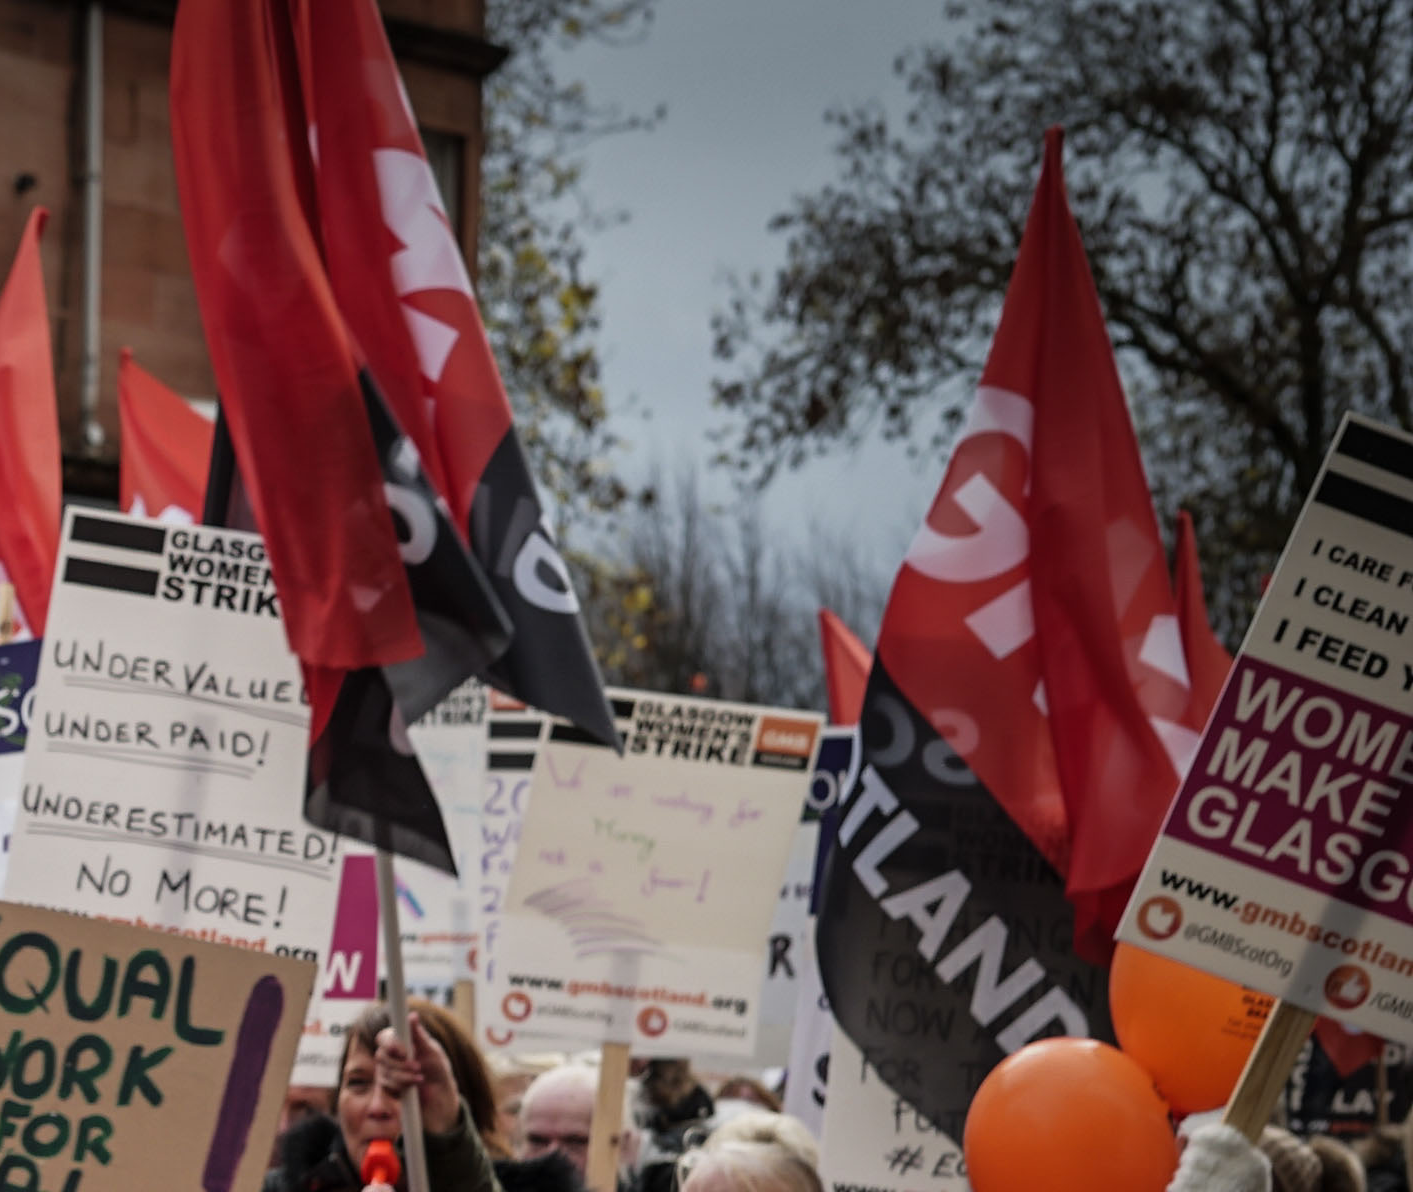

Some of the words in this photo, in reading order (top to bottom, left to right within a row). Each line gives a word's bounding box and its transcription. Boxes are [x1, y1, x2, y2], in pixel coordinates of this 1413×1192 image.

[167, 552, 274, 585] WOMEN
[171, 530, 266, 562] GLASG
[1312, 538, 1323, 557] I
[1328, 543, 1395, 583] CARE
[162, 575, 280, 618] STRIK
[1295, 577, 1307, 598] I
[1313, 583, 1409, 636] CLEAN
[1273, 618, 1290, 643] I
[1295, 630, 1389, 681] FEED
[635, 718, 752, 745] WOMEN'S
[639, 701, 758, 728] GLASGOW
[1234, 667, 1413, 784] WOME
[630, 734, 747, 768] STRIKE
[1205, 726, 1402, 838] MAKE
[22, 784, 341, 864] UNDERESTIMATED!
[1185, 784, 1413, 905] GLASG
[155, 868, 288, 928] MORE!
[837, 763, 1090, 1056] TLAND
[1160, 869, 1413, 978] www.gmbscotlan
[1183, 922, 1294, 978] @GMBScotOrg
[866, 997, 956, 1043] NOW
